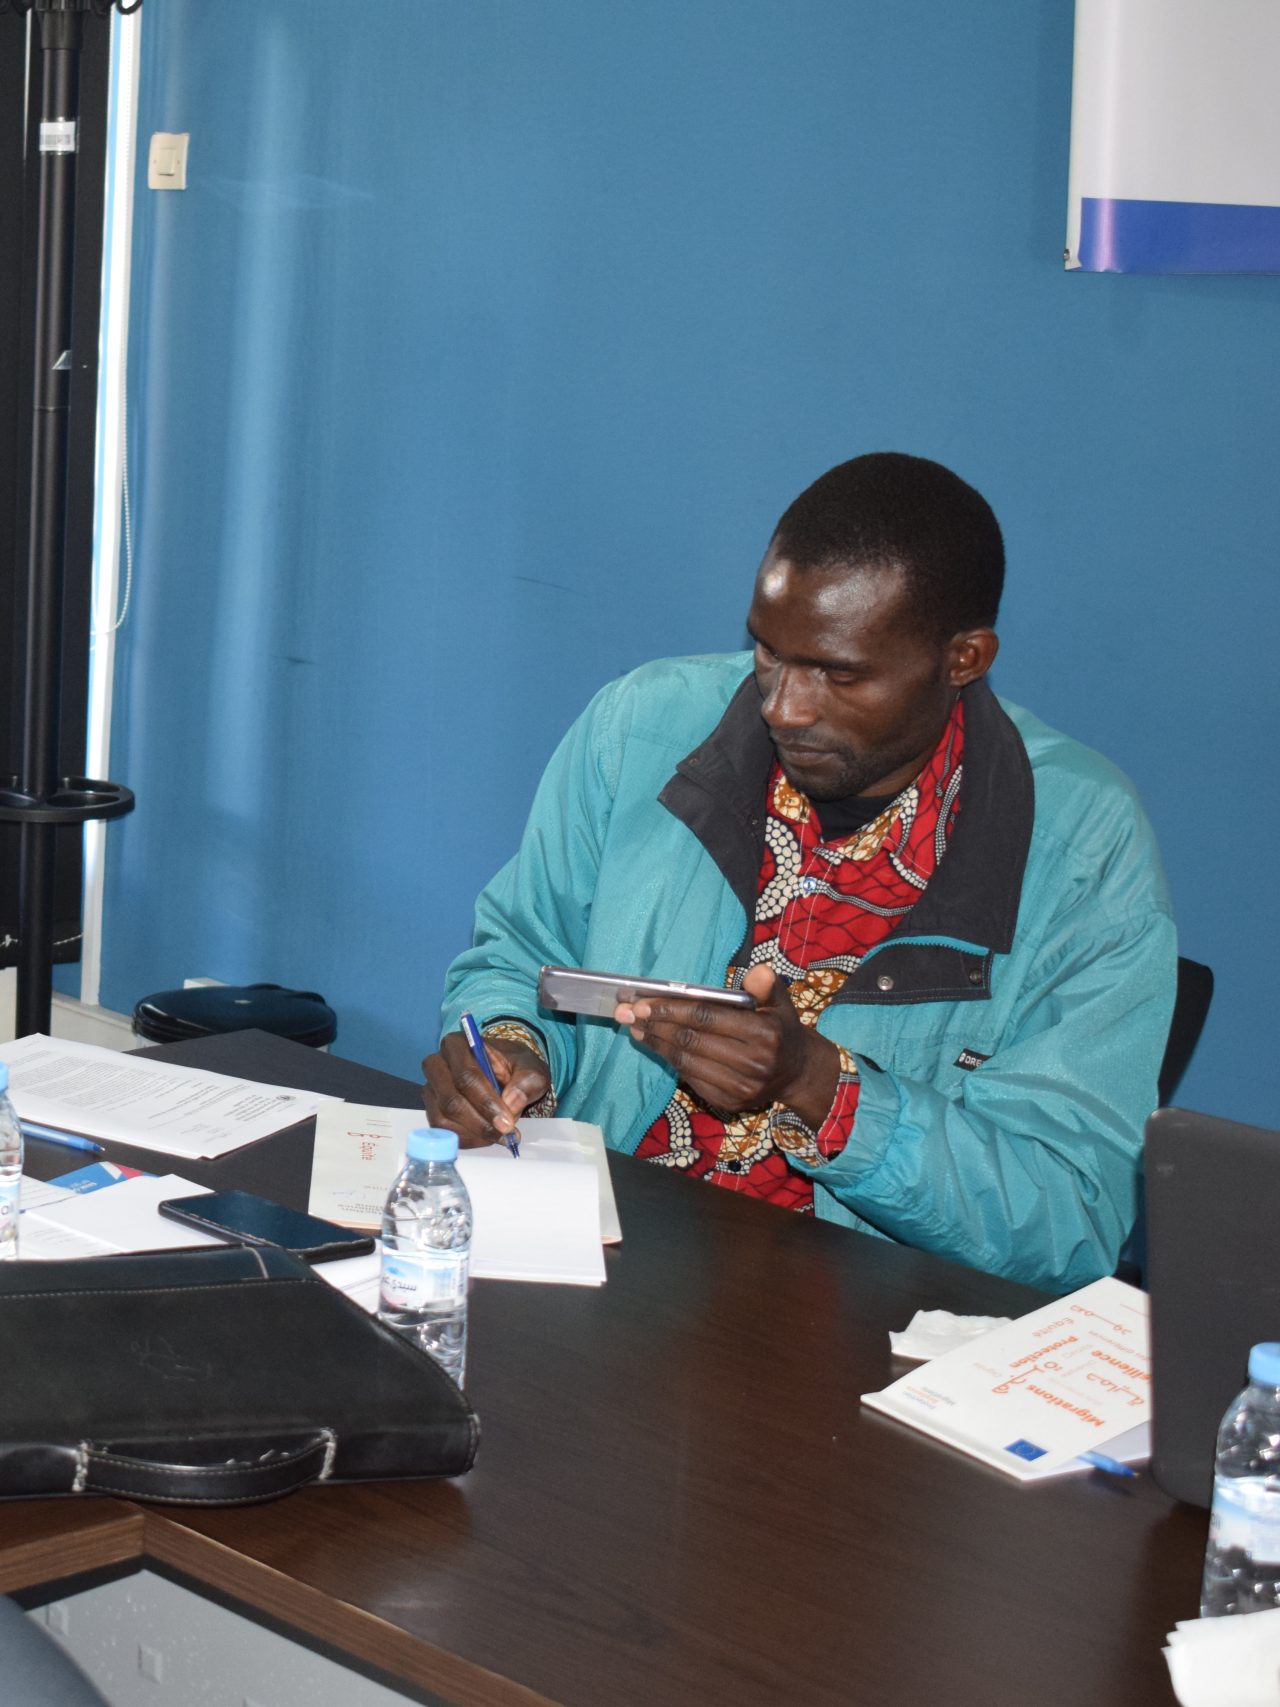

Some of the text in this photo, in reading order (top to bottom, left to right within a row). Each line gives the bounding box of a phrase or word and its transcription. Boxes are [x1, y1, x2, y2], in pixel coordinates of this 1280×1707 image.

[1008, 1335, 1080, 1370] Protection
[1090, 1349, 1152, 1384] silience
[1024, 1383, 1106, 1428] Migrations
